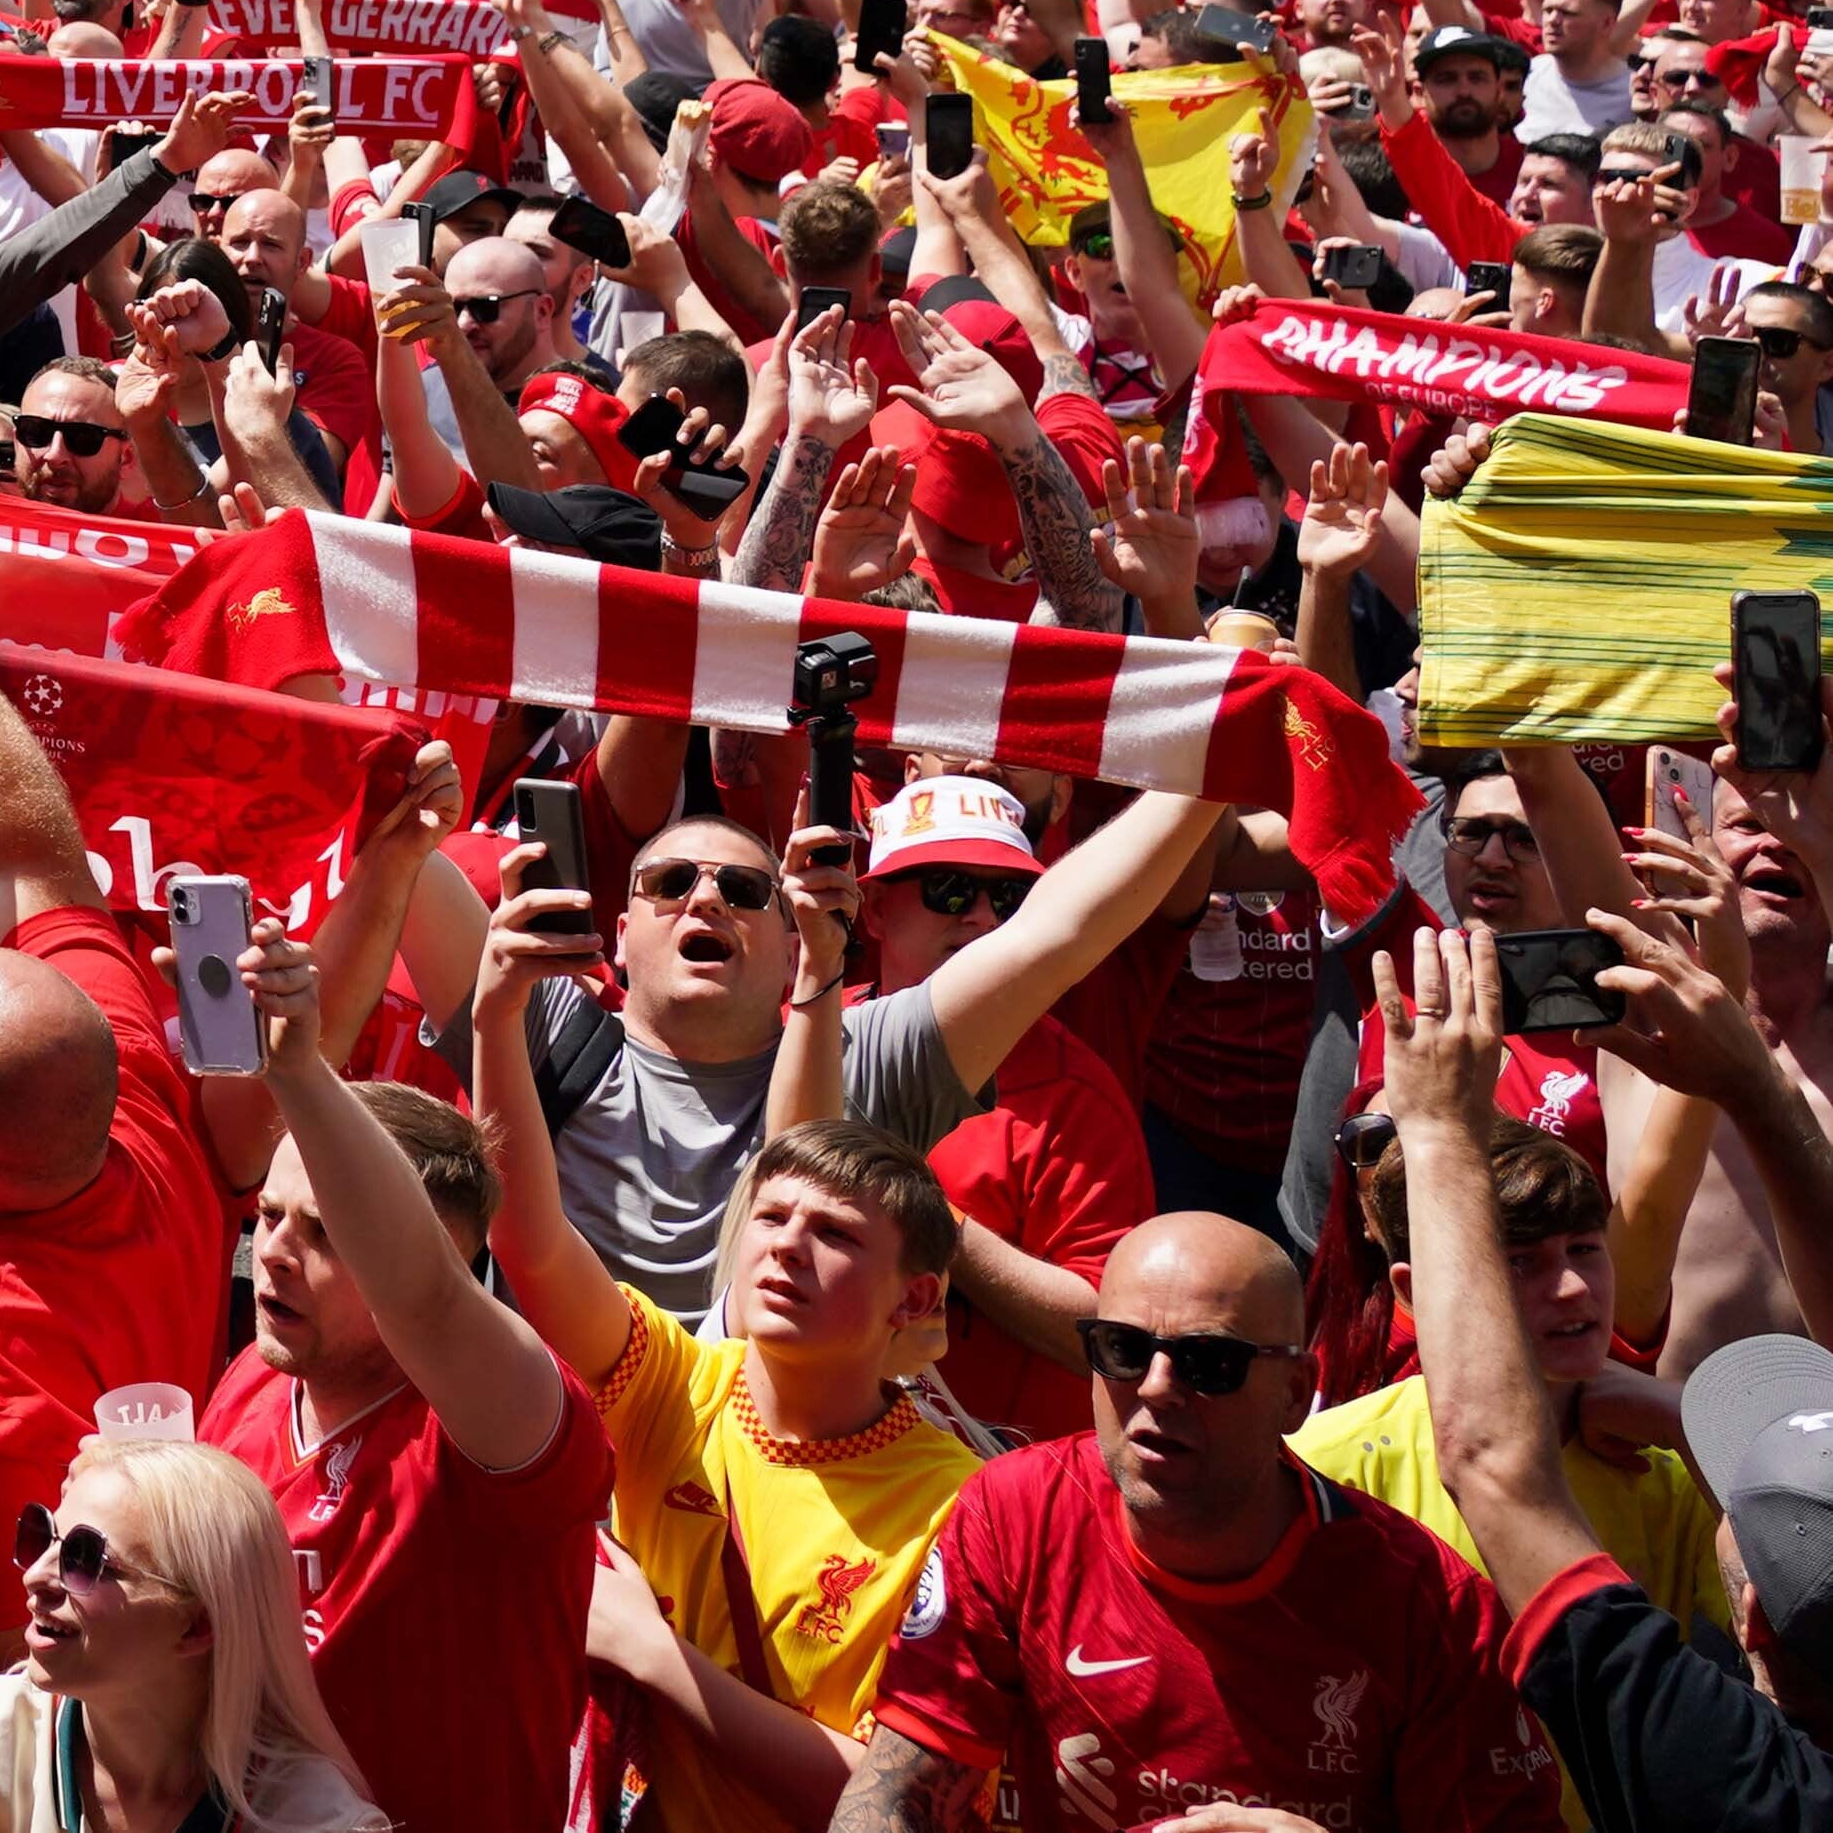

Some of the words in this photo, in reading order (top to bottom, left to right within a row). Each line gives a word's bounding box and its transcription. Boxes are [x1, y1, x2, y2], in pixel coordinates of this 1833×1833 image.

[62, 61, 365, 117] LIVERPOL
[384, 66, 445, 123] FC
[1260, 315, 1629, 413] CHAMPIONS
[1238, 928, 1313, 954] ndard
[1241, 955, 1315, 980] tered
